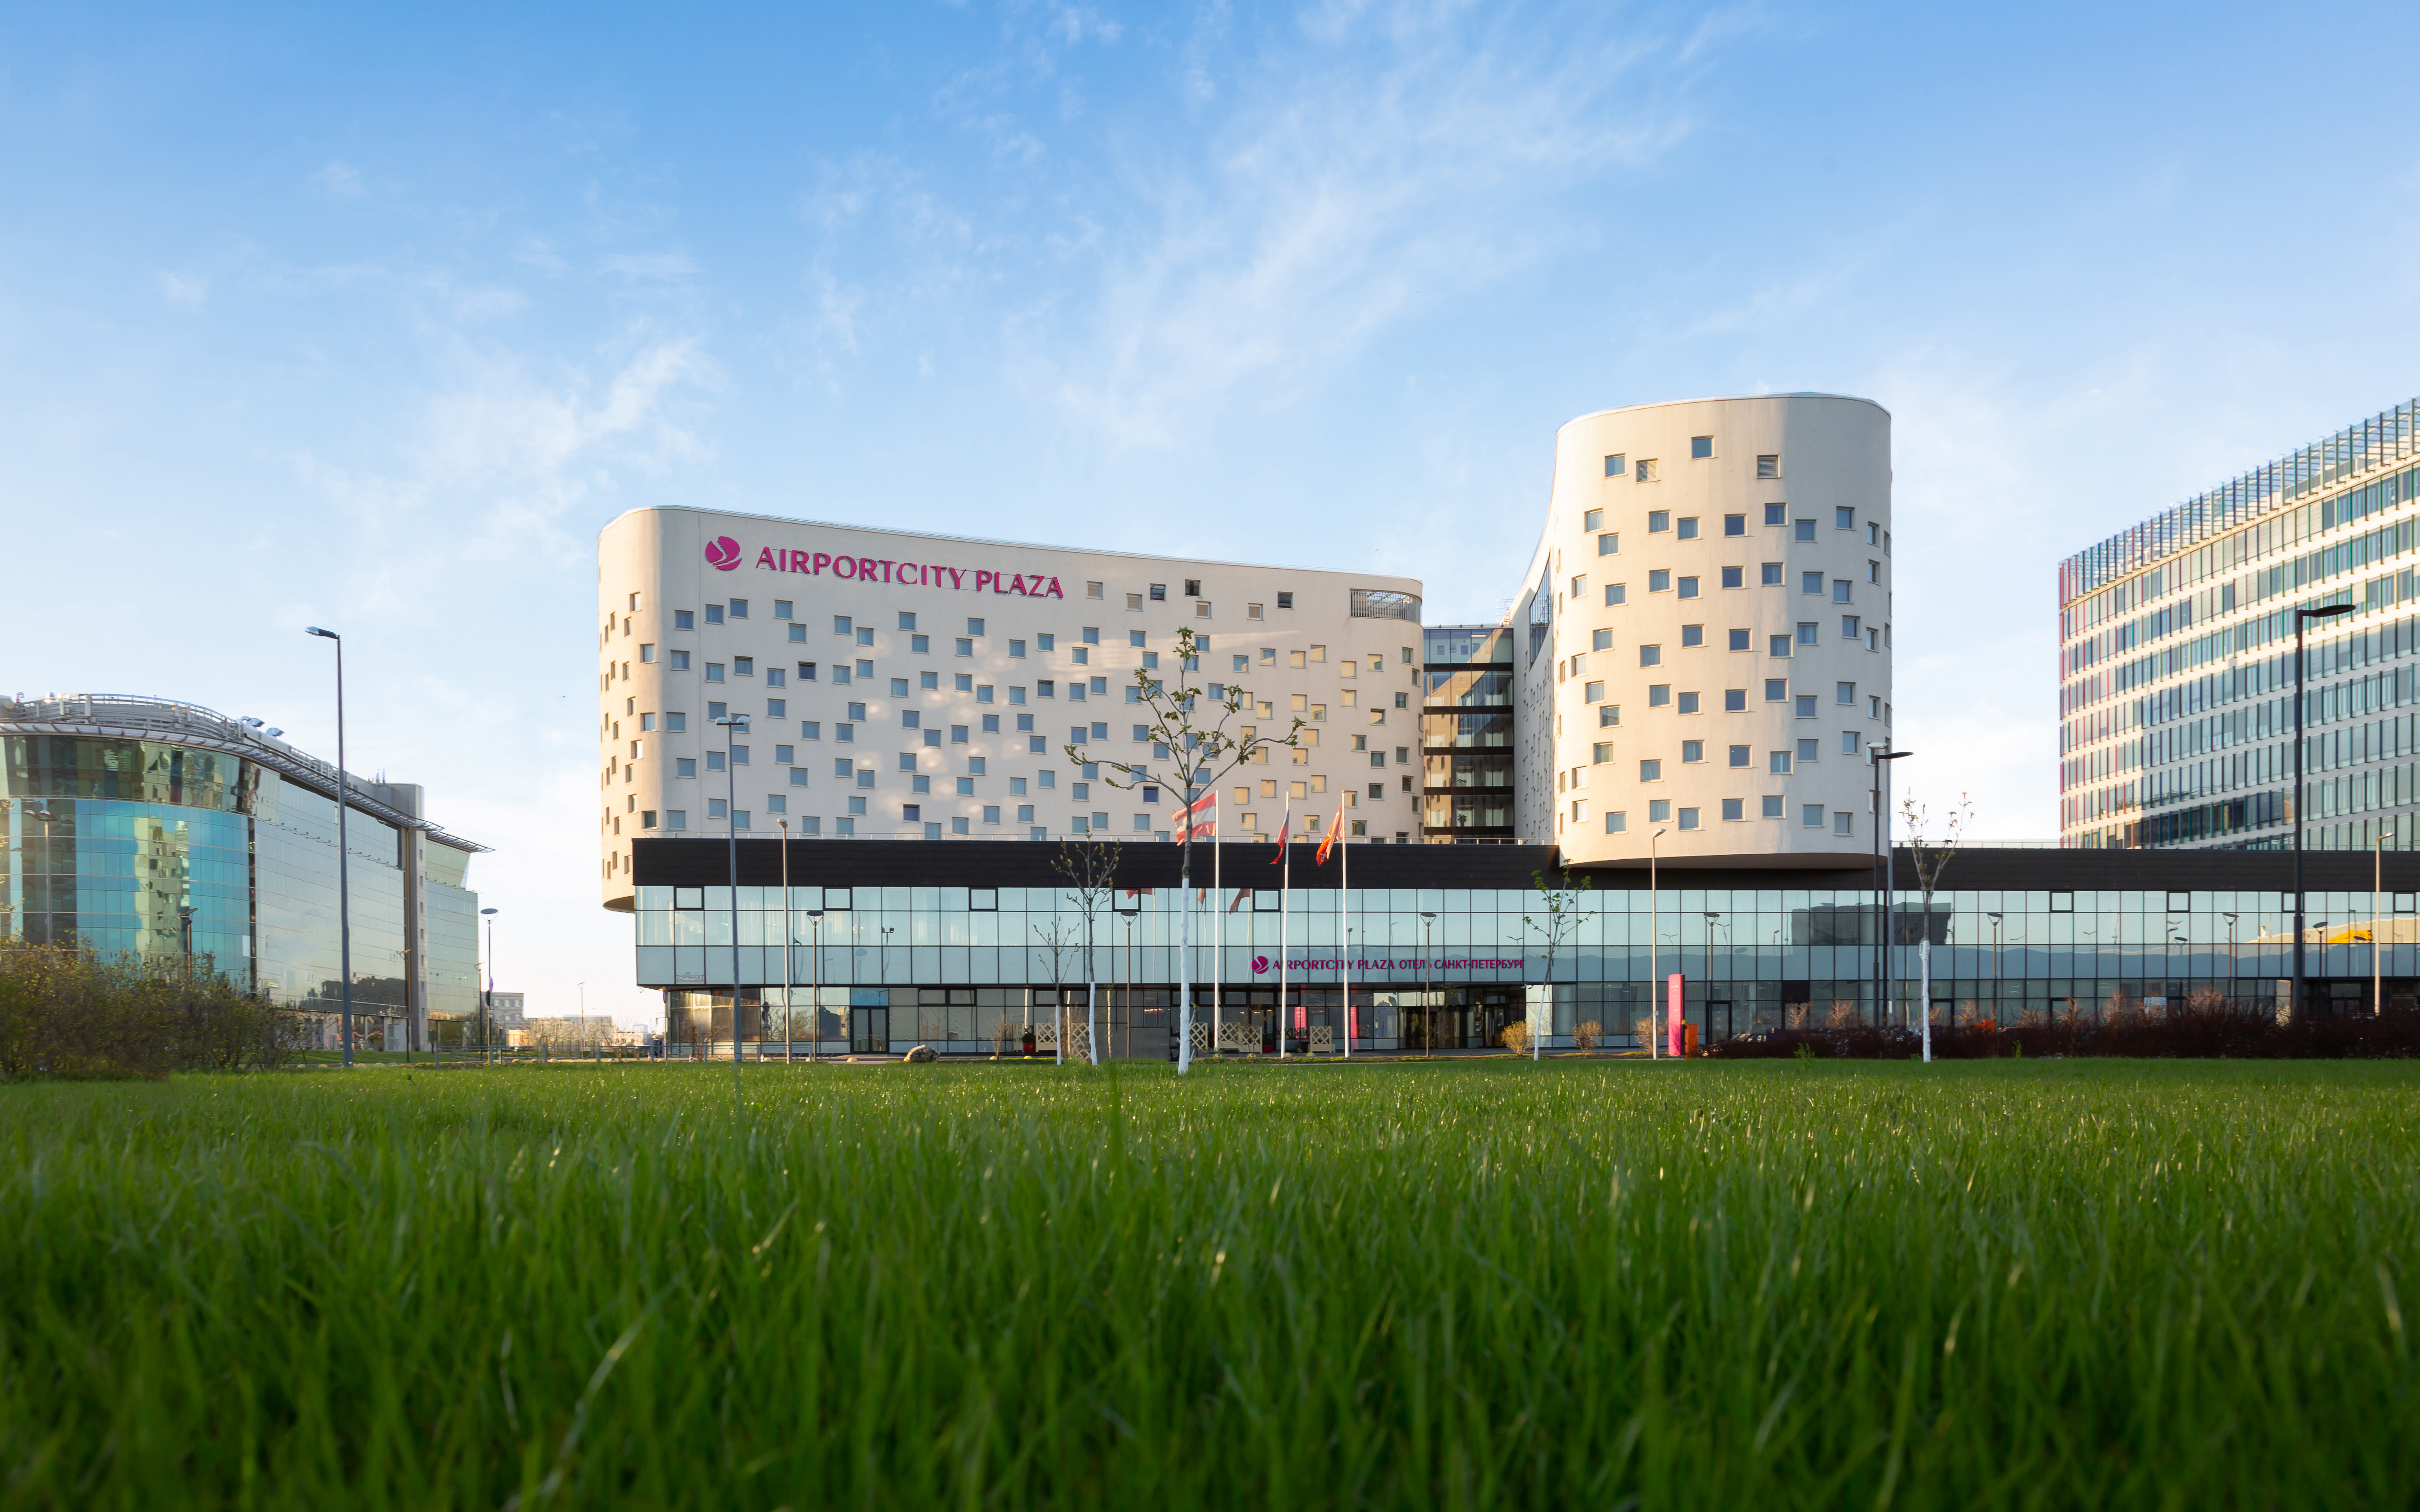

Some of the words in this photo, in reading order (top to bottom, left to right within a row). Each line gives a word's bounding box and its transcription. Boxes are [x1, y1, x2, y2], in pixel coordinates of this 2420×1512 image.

[756, 546, 967, 589] AIRPORTCITY
[977, 570, 1064, 598] PLAZA
[1358, 960, 1394, 969] PLAZA
[1434, 960, 1525, 969] САНКТ-ПЕТЕРБУРГ
